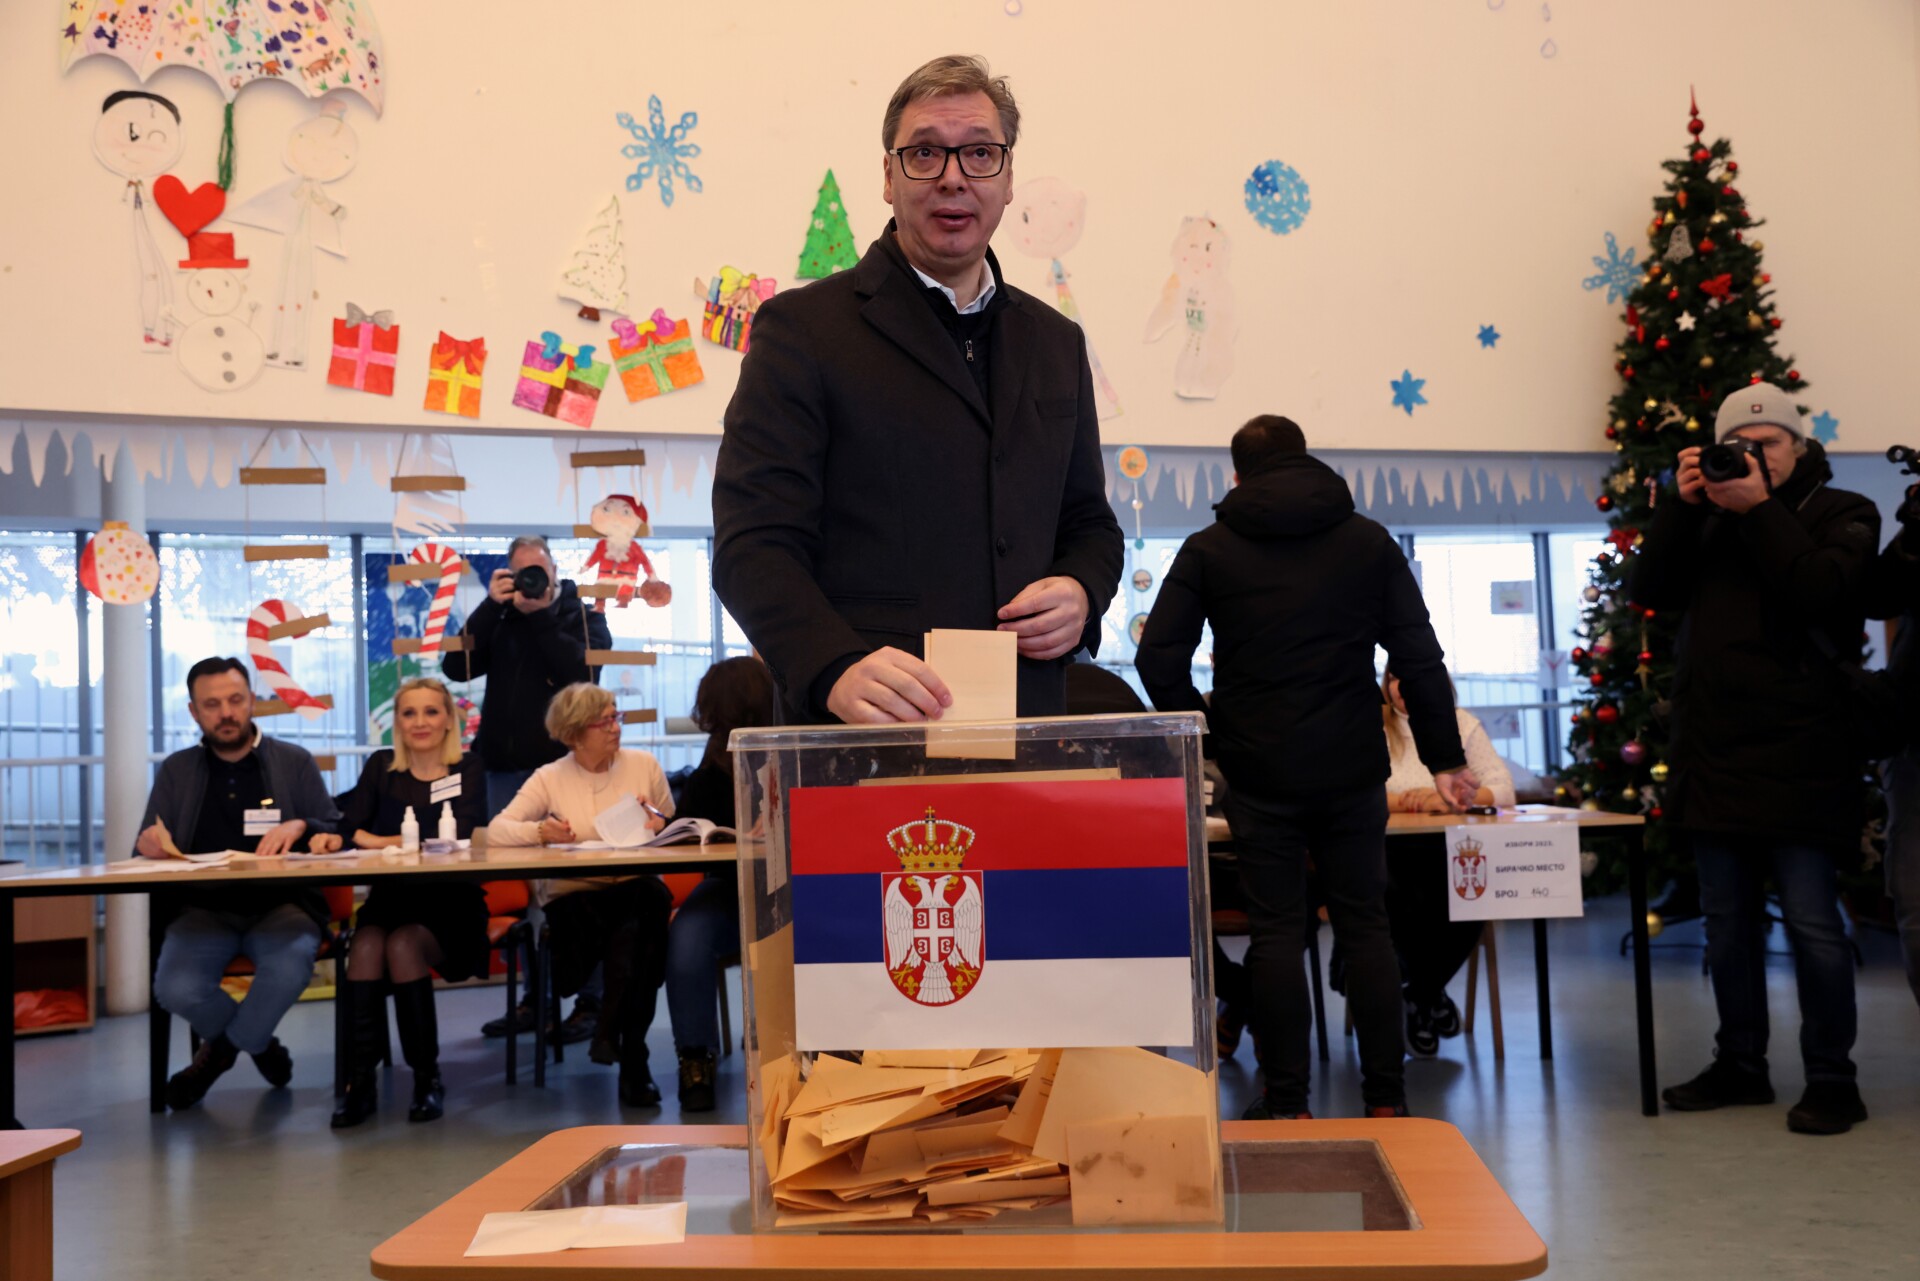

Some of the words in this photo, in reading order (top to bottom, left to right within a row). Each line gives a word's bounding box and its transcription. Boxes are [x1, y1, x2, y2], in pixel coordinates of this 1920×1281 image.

[1495, 865, 1534, 873] БИРАЧКО
[1536, 863, 1565, 872] МЕСТО
[1495, 889, 1518, 898] БРОЈ
